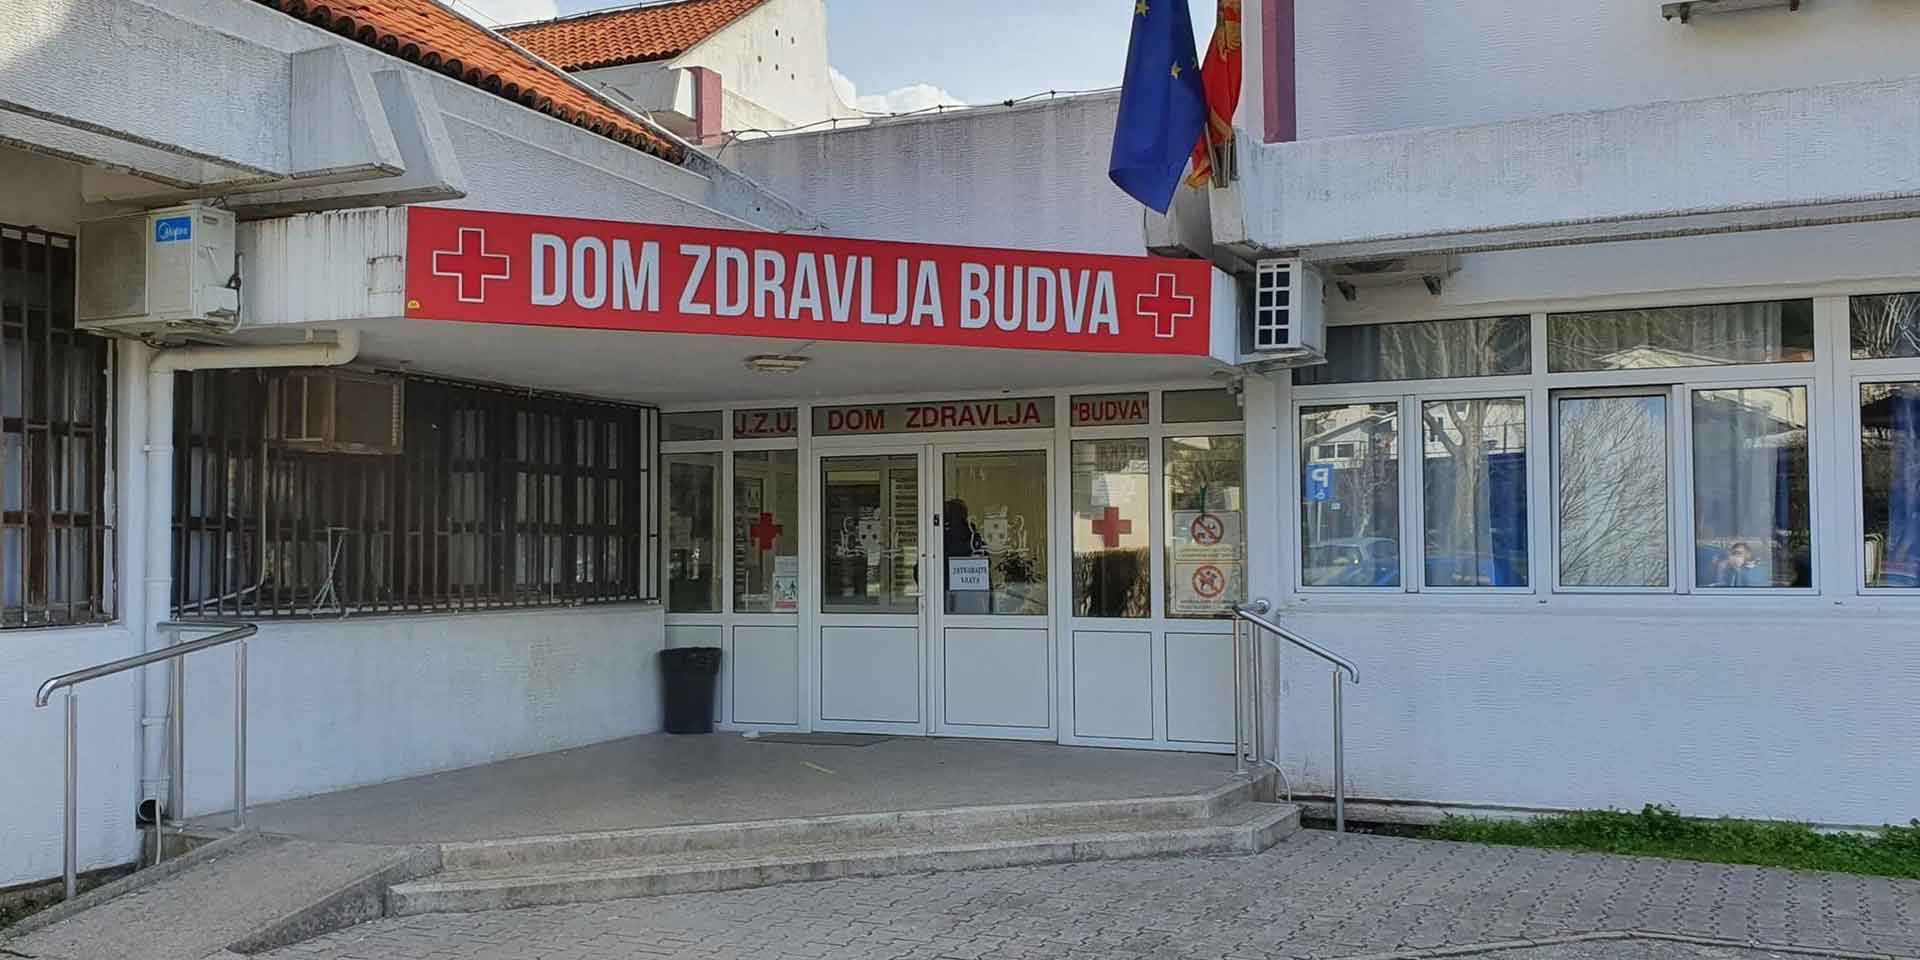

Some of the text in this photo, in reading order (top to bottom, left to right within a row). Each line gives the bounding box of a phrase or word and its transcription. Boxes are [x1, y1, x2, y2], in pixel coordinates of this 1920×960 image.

[530, 232, 1120, 335] DOM ZDRAVLJA BUDVA
[735, 399, 1148, 433] J.Z.U. DOM ZDRAVLJA "BUDVA"
